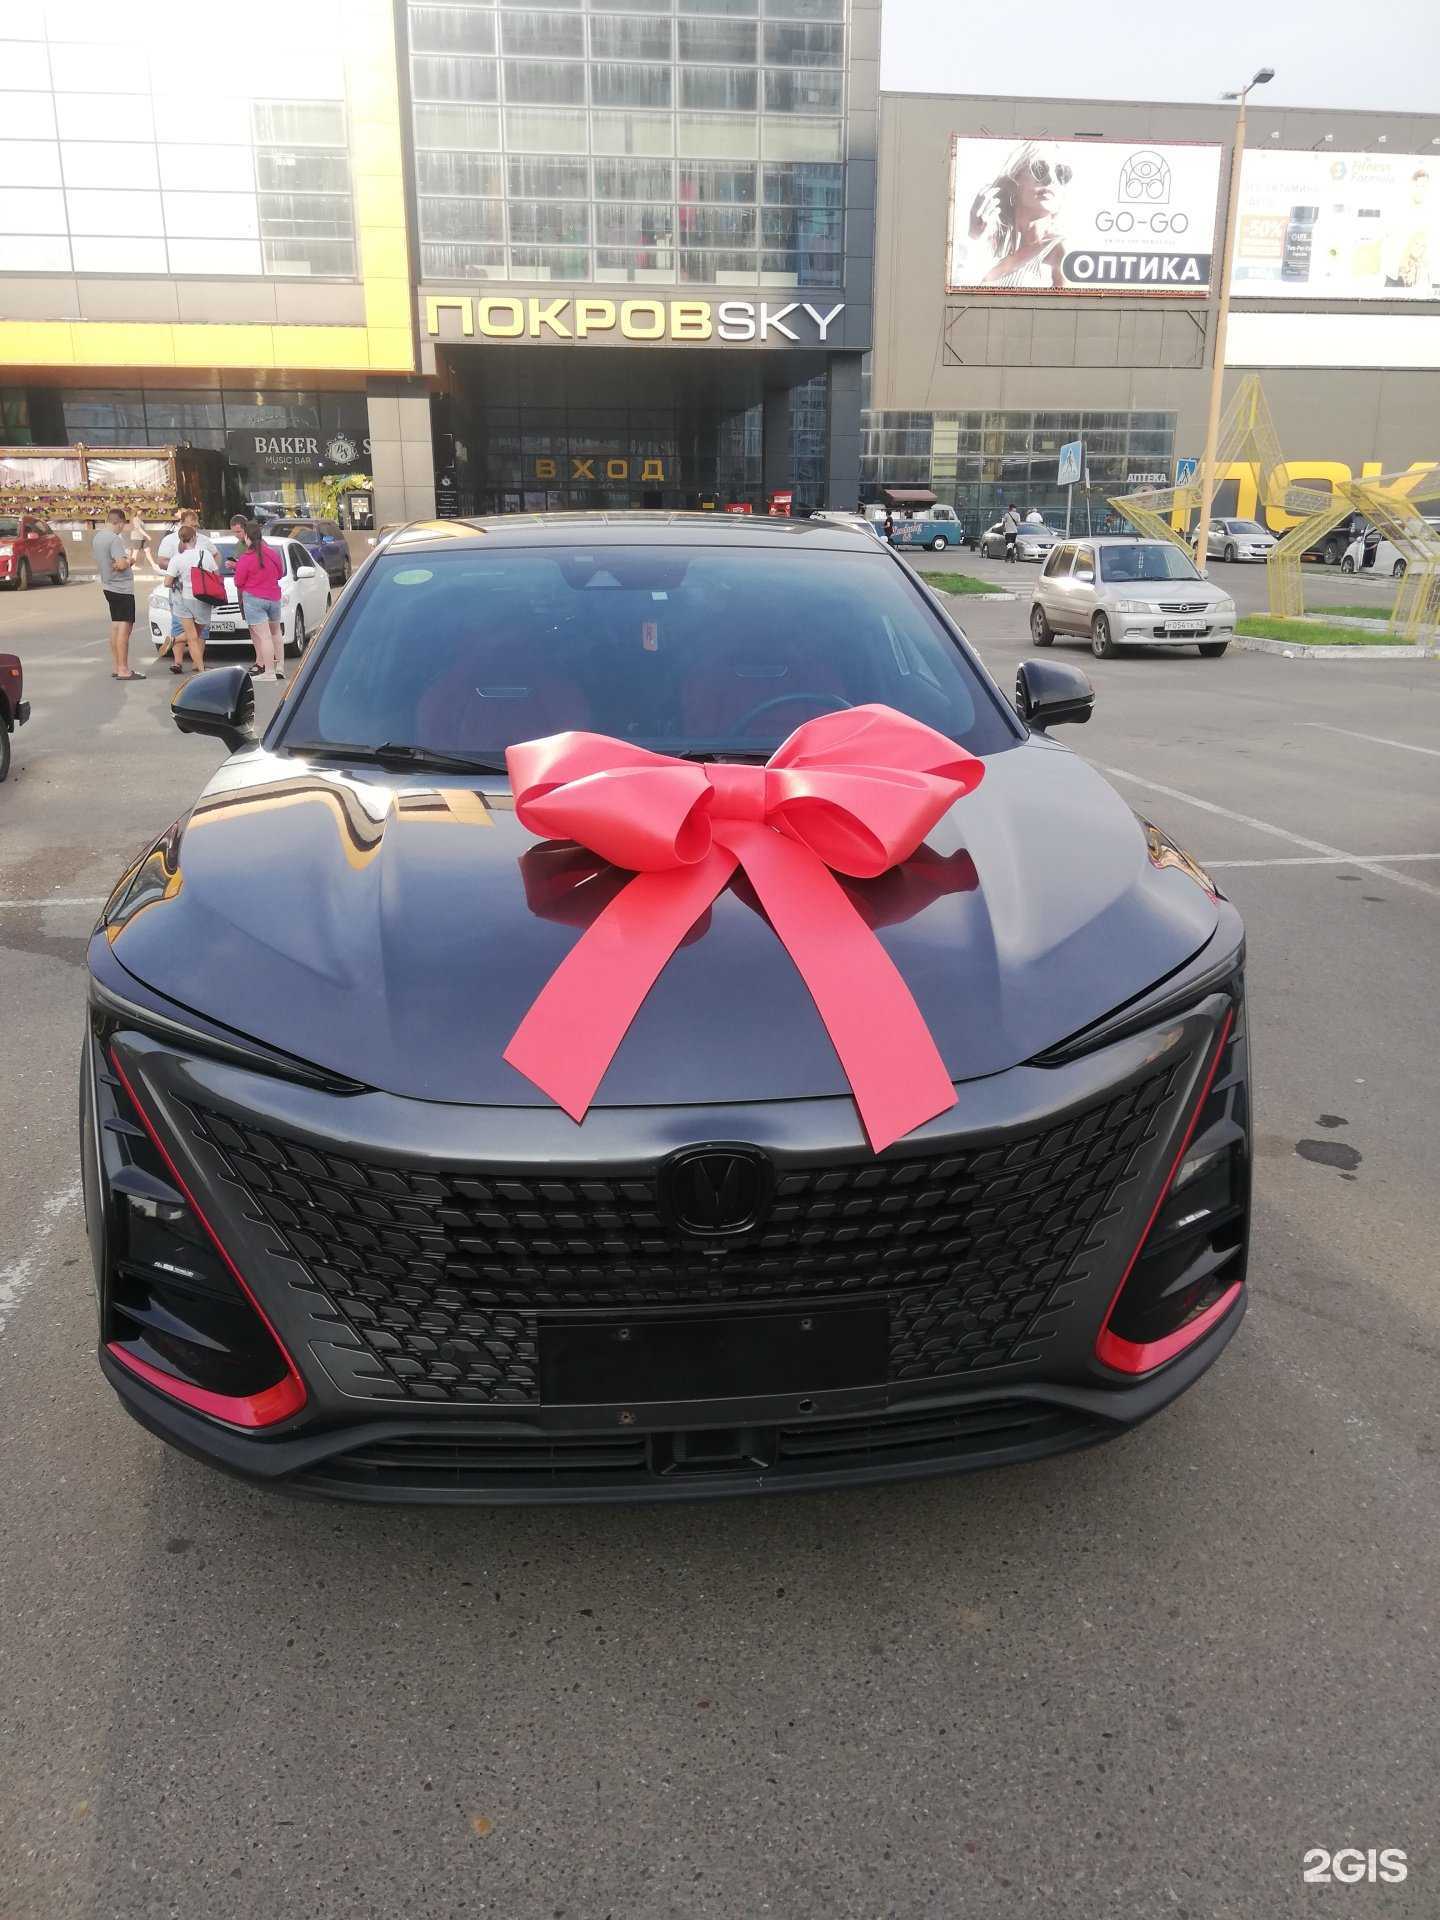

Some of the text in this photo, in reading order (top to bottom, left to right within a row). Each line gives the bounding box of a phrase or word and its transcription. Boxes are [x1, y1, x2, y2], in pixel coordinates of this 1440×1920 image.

[1095, 211, 1189, 233] GO-GO
[1073, 254, 1201, 281] ОПТИКА
[426, 296, 846, 341] ПОКРОВSKY
[254, 436, 319, 454] BAKER
[265, 456, 312, 465] MUSIC BAR
[535, 459, 664, 481] ВХОД
[1127, 473, 1167, 483] АПТЕКА
